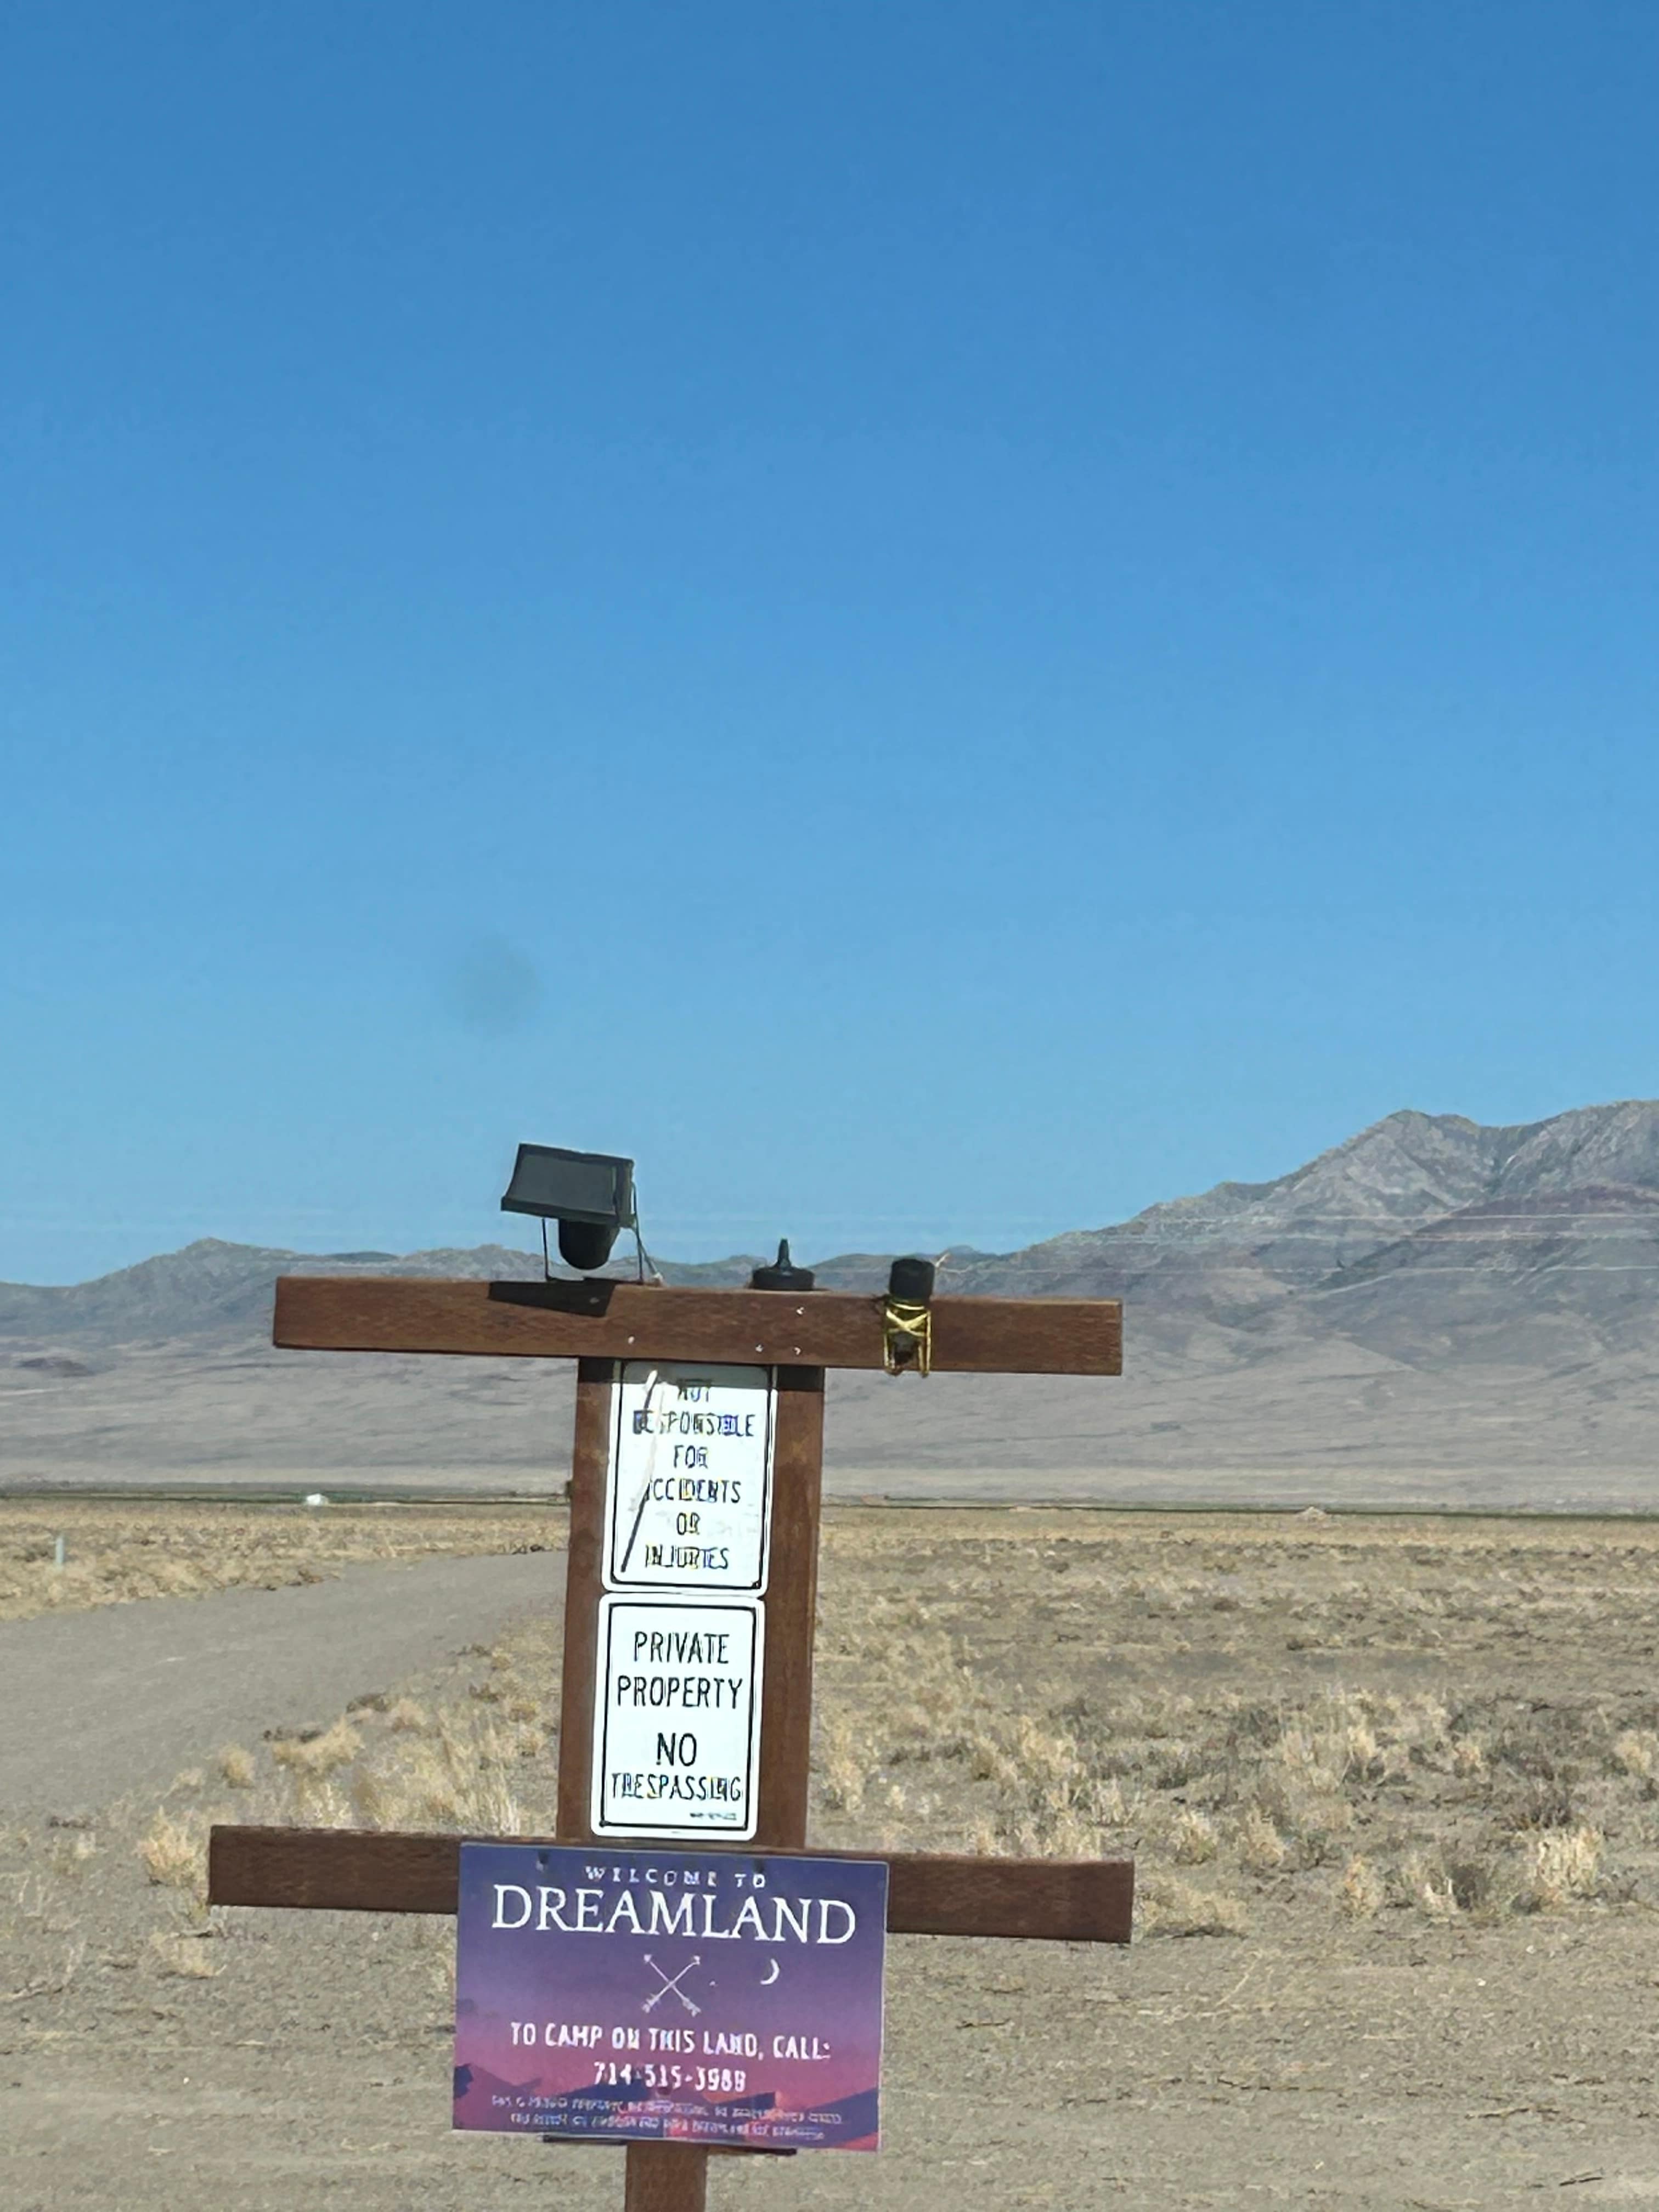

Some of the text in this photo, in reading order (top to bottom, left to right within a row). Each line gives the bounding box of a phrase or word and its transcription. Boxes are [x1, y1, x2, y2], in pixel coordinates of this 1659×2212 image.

[673, 1445, 709, 1468] FOR
[676, 1512, 701, 1536] OR
[645, 1543, 730, 1570] INJURIES
[634, 1631, 730, 1664] PRIVATE
[618, 1675, 743, 1709] PROPERTY
[656, 1733, 697, 1767] NO
[611, 1772, 741, 1802] TRESPASSING
[585, 1866, 766, 1888] WELCOME TO
[492, 1883, 856, 1944] DREAMLAND
[511, 2022, 831, 2061] TO CAMP ON THIS LAND, CALL:
